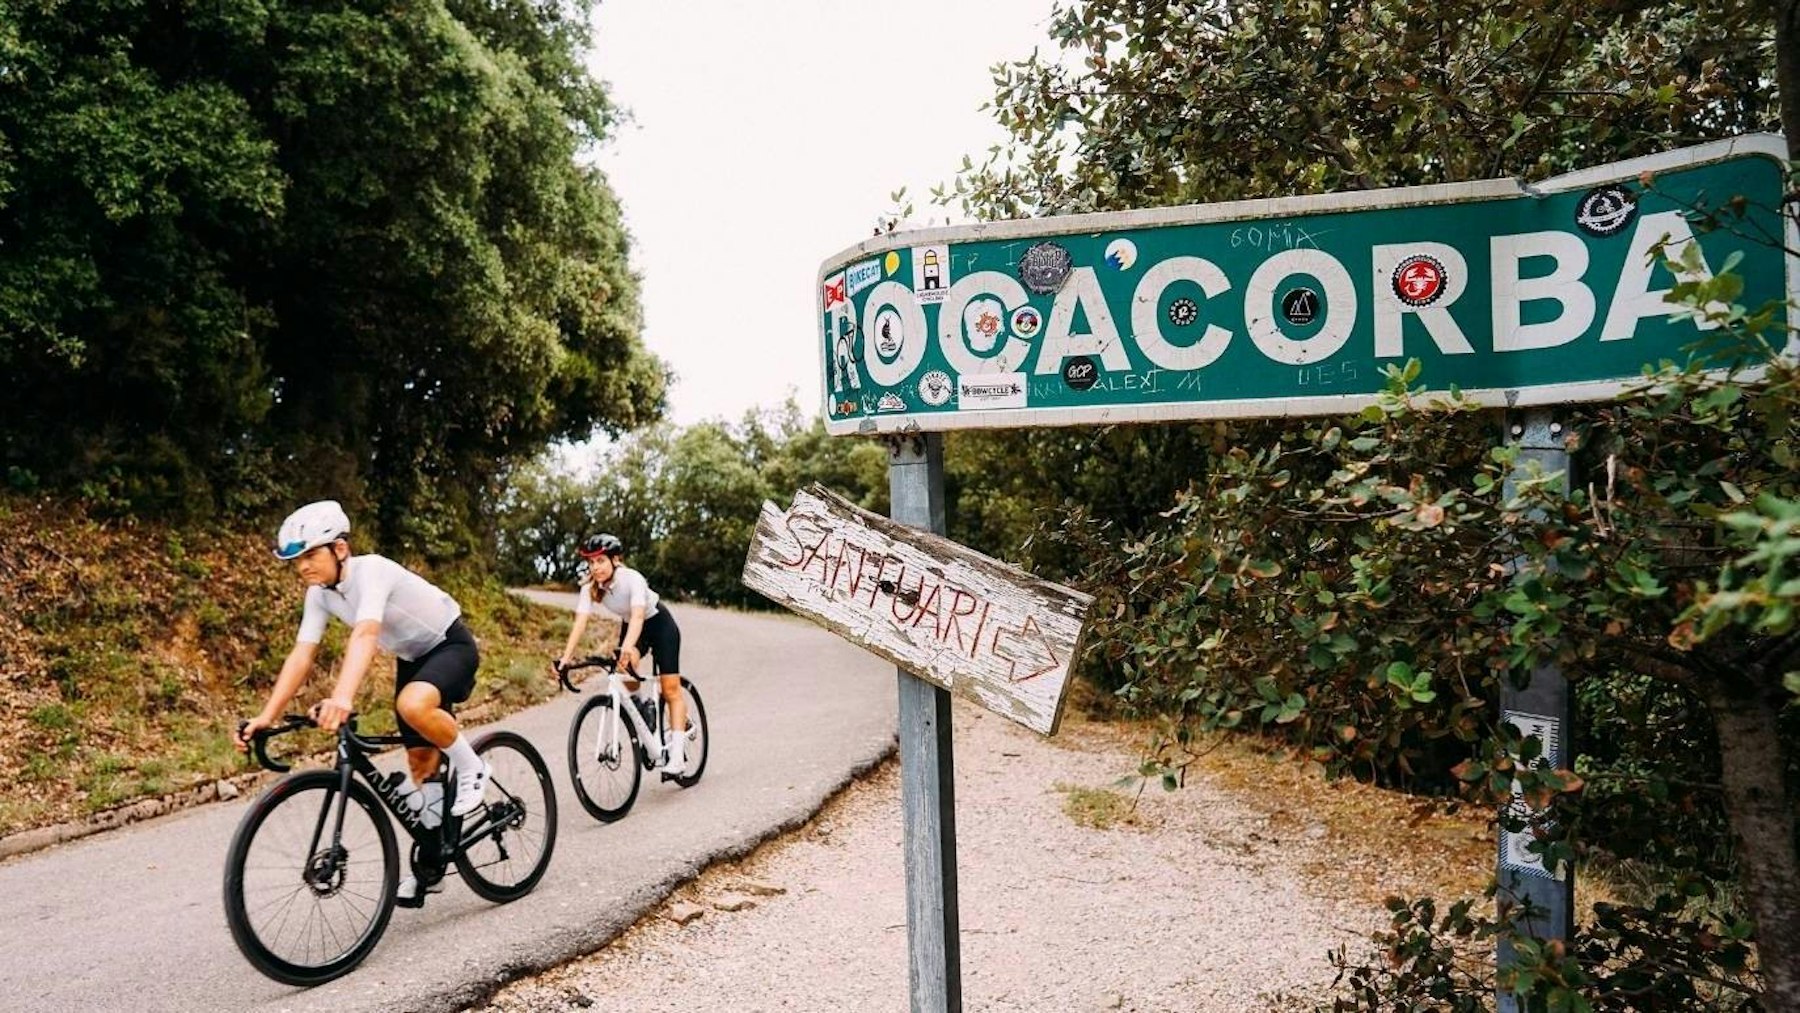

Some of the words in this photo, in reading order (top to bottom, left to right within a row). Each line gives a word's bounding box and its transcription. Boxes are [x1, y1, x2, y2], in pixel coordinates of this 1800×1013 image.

[831, 210, 1730, 392] ROCACORBA
[849, 264, 880, 290] BIKECAT
[1068, 364, 1092, 378] GCP
[780, 511, 989, 659] SANTUARI
[366, 769, 421, 829] AURUM
